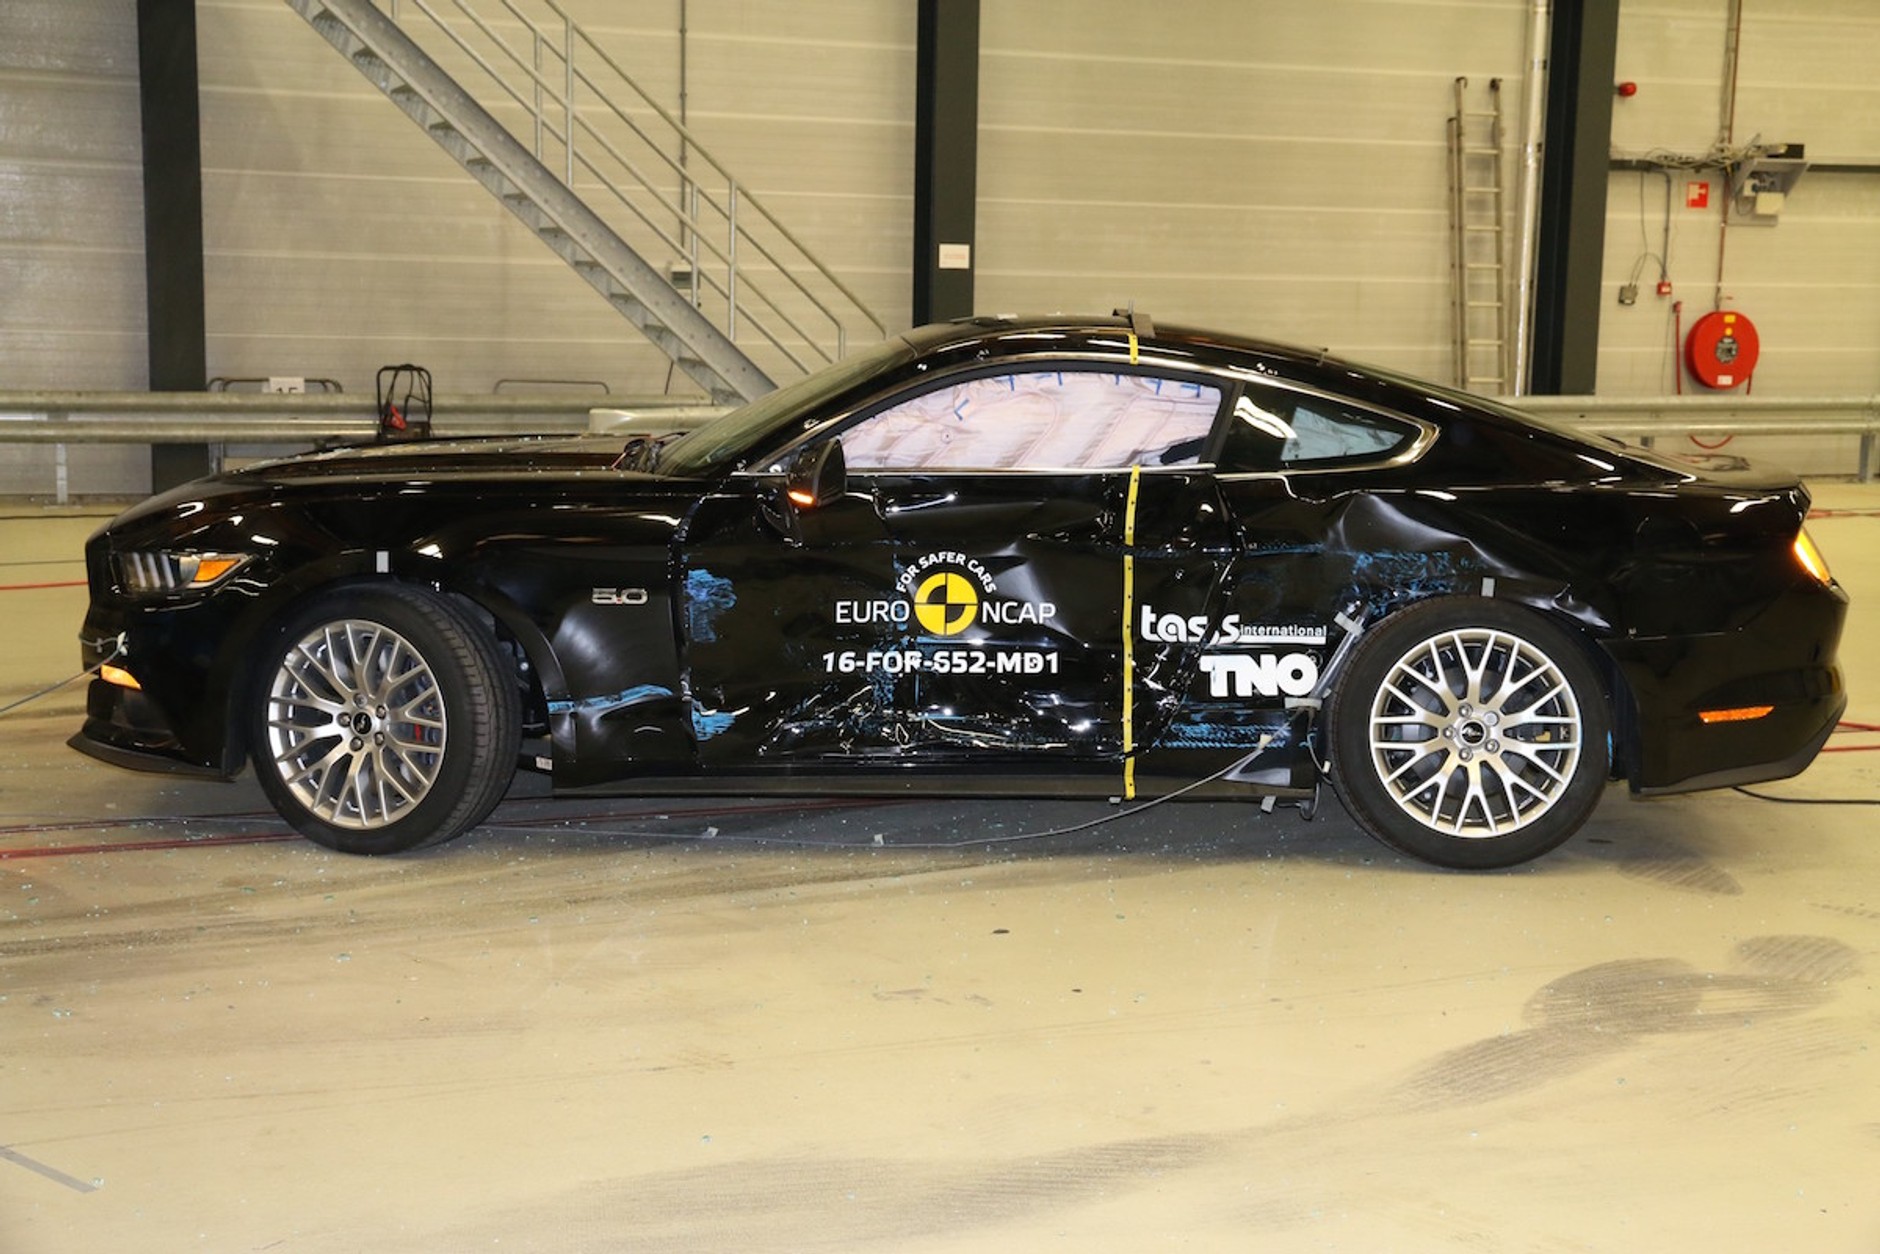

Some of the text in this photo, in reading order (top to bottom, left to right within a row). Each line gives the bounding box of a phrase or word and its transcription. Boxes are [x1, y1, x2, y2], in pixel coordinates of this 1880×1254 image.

[896, 552, 997, 594] FOR SAFER CARS
[592, 588, 648, 604] 5.0
[835, 600, 1056, 624] EURO NCAP
[1240, 625, 1327, 637] international
[823, 651, 1059, 674] 16-FOR-S52-MD1
[1199, 653, 1318, 697] TNO
